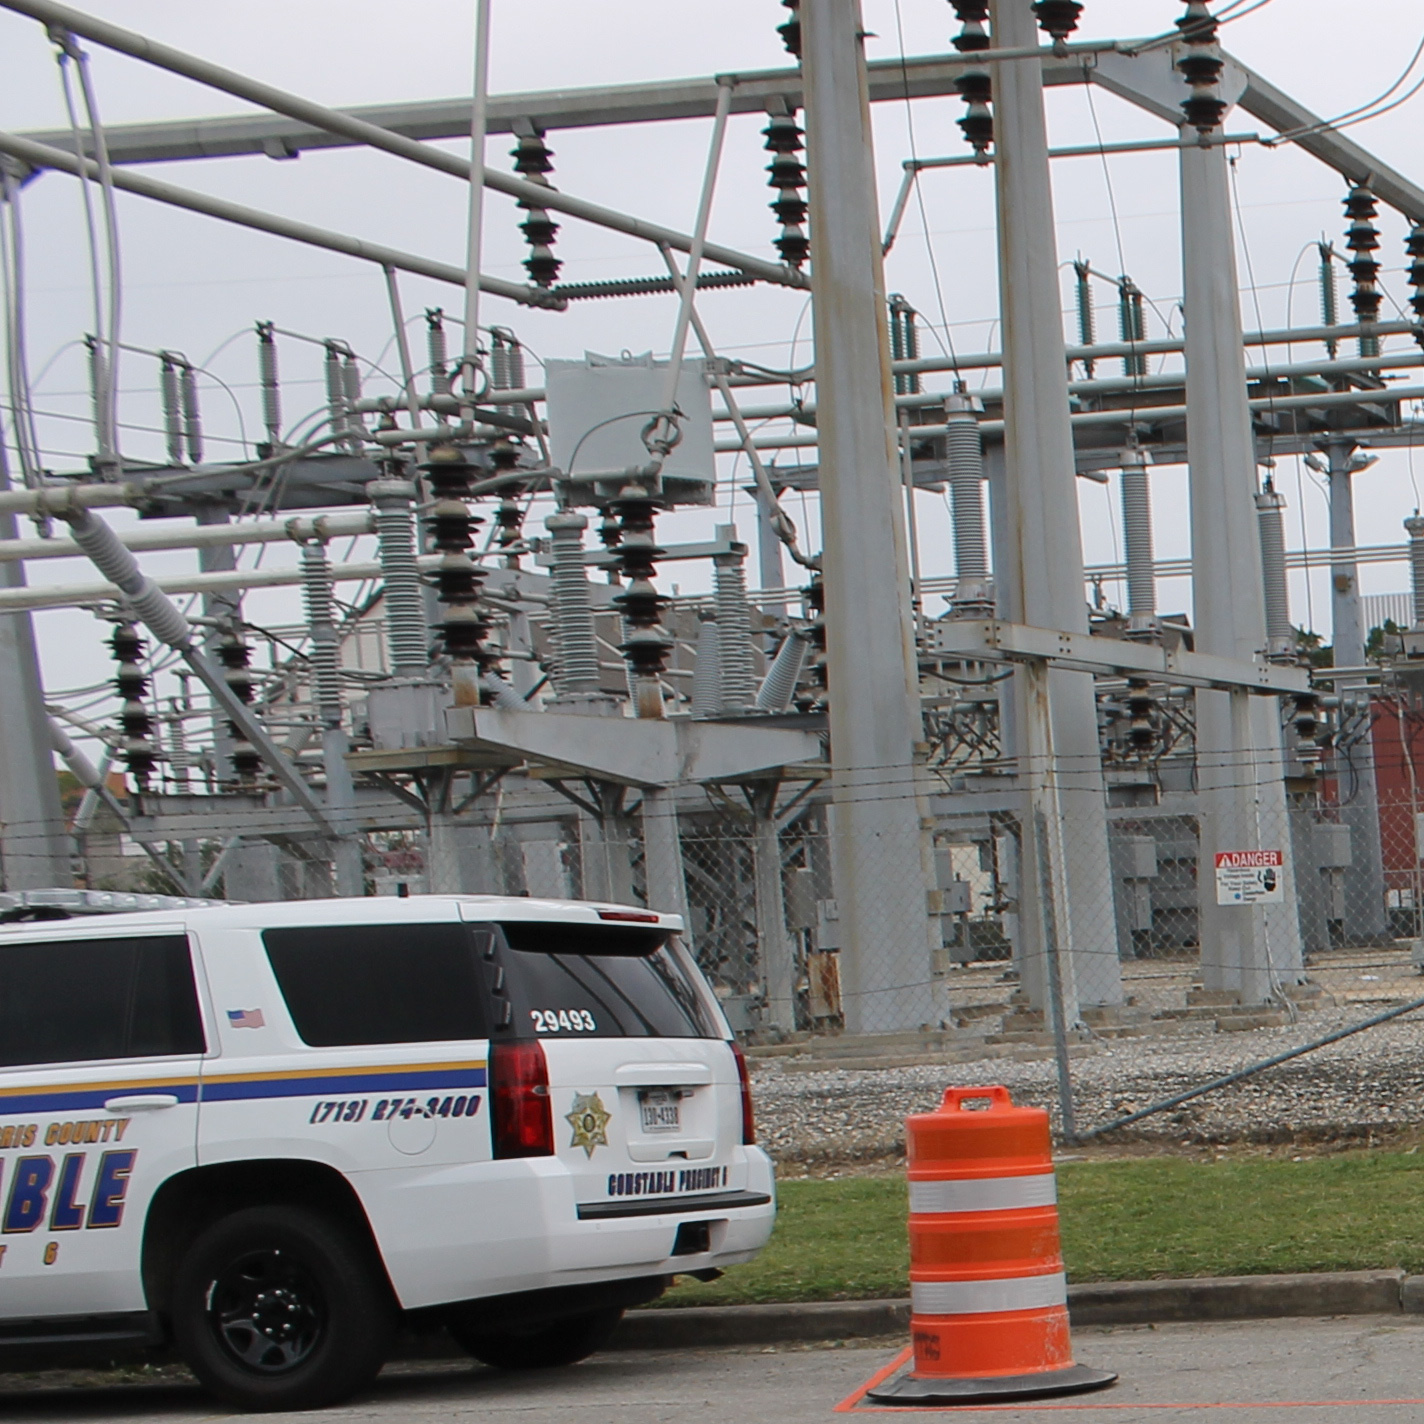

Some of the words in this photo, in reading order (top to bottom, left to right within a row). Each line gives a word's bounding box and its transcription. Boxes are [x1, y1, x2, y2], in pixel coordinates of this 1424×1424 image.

[1232, 852, 1278, 867] DANGER
[530, 1009, 597, 1032] 29493
[310, 1100, 368, 1124] (713)
[371, 1095, 482, 1121] 274-3400
[45, 1117, 132, 1146] COUNTY
[0, 1148, 139, 1235] BLE
[43, 1241, 60, 1266] 6
